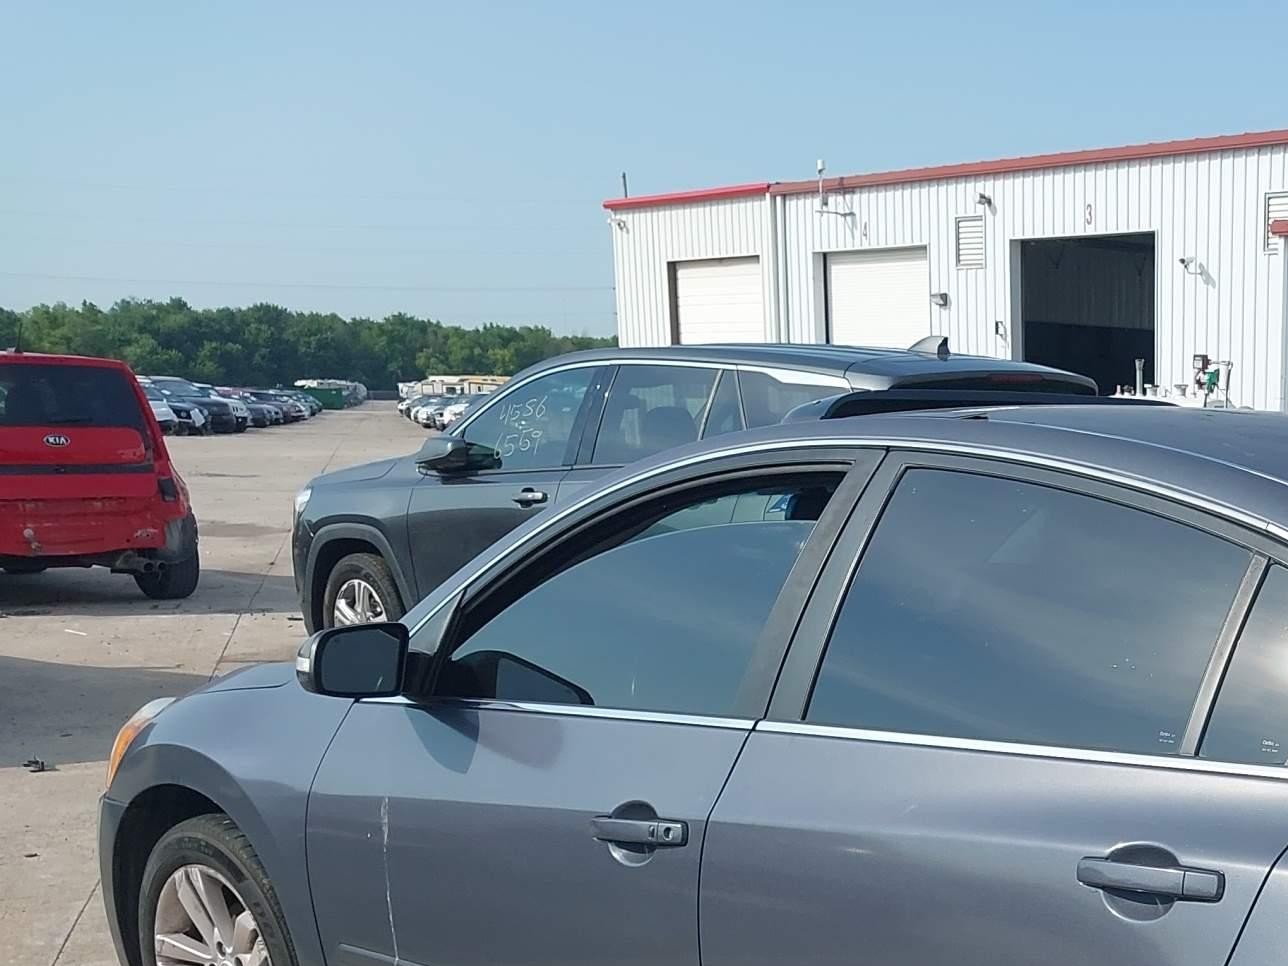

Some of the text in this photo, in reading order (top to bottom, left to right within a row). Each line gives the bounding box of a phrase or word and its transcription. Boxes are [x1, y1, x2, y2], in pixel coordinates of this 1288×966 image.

[1086, 203, 1093, 226] 3
[862, 220, 868, 241] 4
[499, 395, 548, 424] 4556
[47, 436, 68, 446] KIA
[493, 428, 543, 459] 6559
